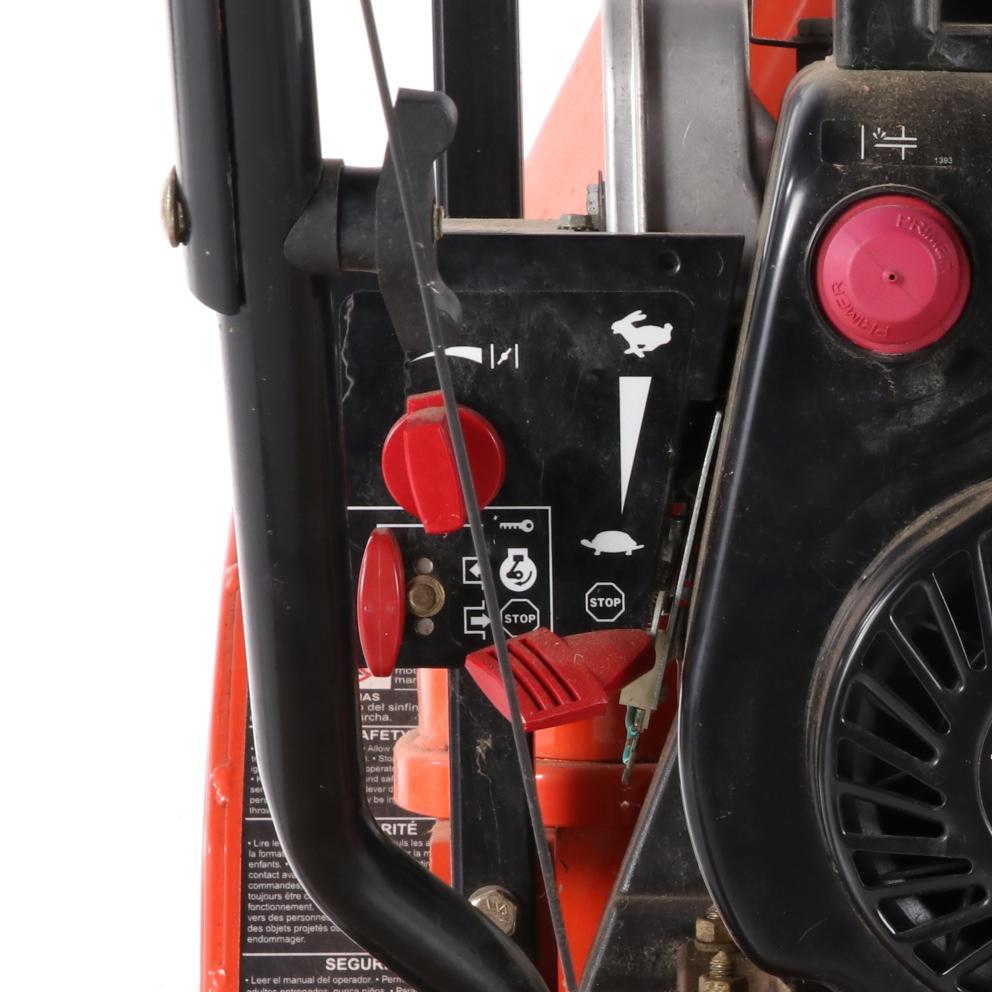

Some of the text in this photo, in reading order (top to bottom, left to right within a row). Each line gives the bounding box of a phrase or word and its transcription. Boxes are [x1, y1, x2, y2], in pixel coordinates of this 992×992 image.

[590, 597, 621, 607] STOP
[504, 613, 536, 624] STOP
[367, 703, 385, 711] del
[253, 840, 270, 848] Lire
[248, 861, 282, 869] enfants.
[248, 871, 280, 879] contact
[247, 893, 282, 902] toujours
[285, 892, 302, 900] être
[247, 903, 314, 911] fonctionnement.
[268, 914, 284, 922] des
[265, 925, 292, 934] objets
[293, 924, 329, 934] projetés
[247, 936, 306, 944] endommager.
[251, 976, 270, 985] Leer
[272, 976, 281, 984] el
[283, 976, 315, 984] manual
[317, 976, 331, 984] del
[332, 976, 374, 986] operador.
